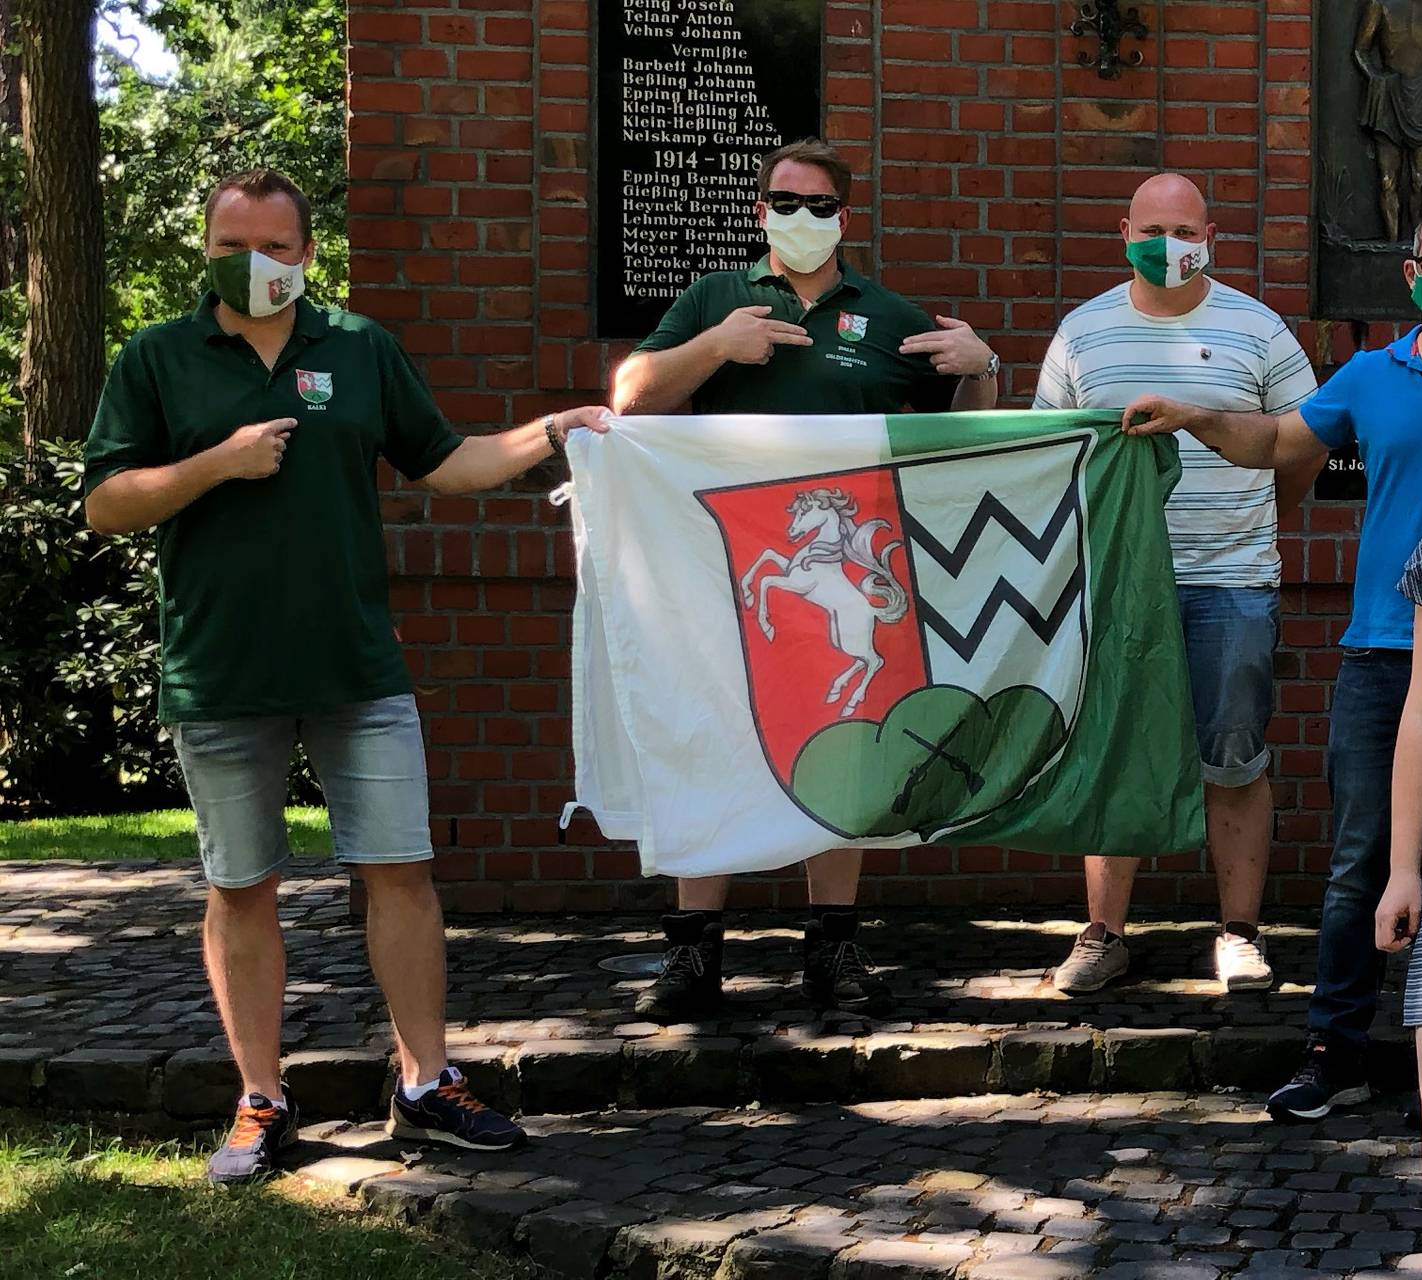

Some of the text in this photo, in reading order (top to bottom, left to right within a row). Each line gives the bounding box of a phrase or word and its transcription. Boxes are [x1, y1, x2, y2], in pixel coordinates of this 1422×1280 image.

[678, 0, 734, 12] Josefa
[624, 10, 733, 26] Telaar Anton
[624, 23, 742, 40] Vehns Johann
[672, 44, 747, 60] Vermißte
[623, 58, 753, 75] Barbett Johann
[623, 72, 756, 90] Beßling Johann
[623, 87, 758, 103] Epping Heinrich
[623, 101, 770, 120] Klein-Heßling Alf.
[623, 115, 777, 134] Klein-Heßling Jos.
[623, 129, 782, 146] Nelskamp Gerhard
[655, 150, 698, 169] 1914
[720, 152, 762, 171] 1918
[623, 170, 758, 187] Epping Bernhar
[623, 185, 761, 201] Gießing Bernha
[623, 199, 757, 214] Heynck Bernhar
[623, 213, 716, 227] Lehmbrock
[623, 227, 764, 243] Meyer Bernhard
[623, 241, 747, 256] Meyer Johann
[624, 255, 691, 269] Tebroke
[624, 270, 684, 283] Teriete
[624, 284, 684, 298] Wennin
